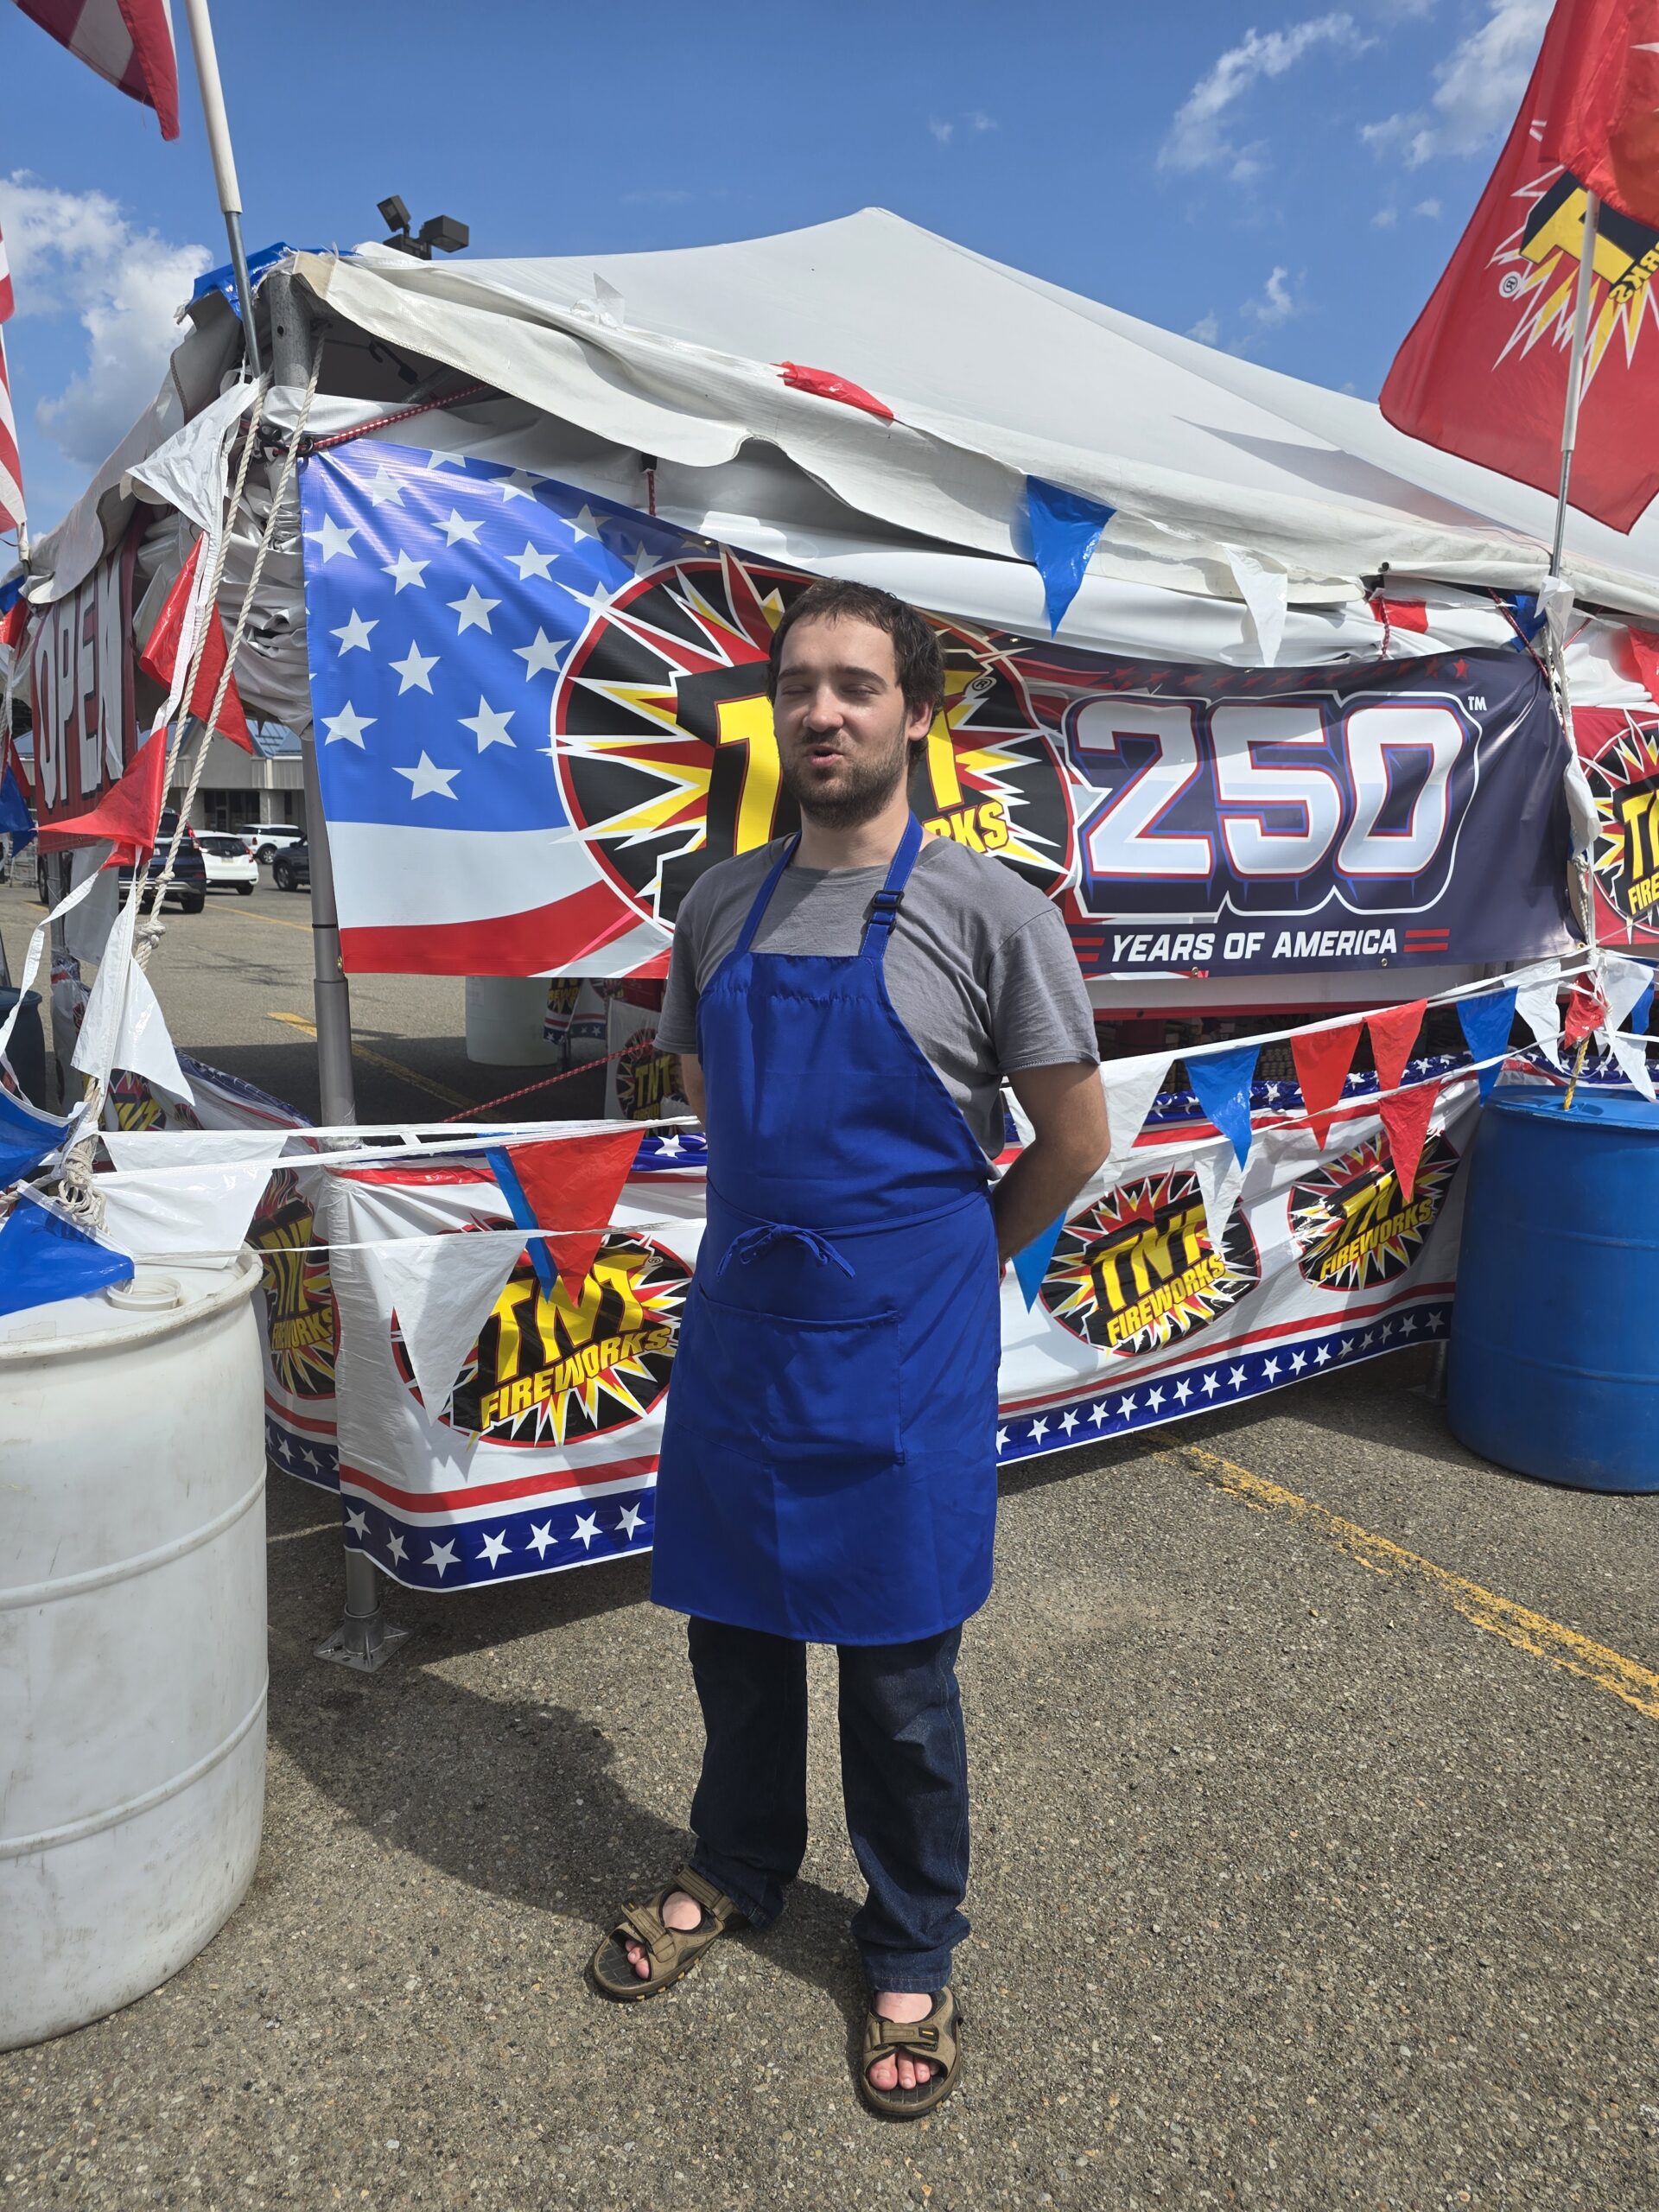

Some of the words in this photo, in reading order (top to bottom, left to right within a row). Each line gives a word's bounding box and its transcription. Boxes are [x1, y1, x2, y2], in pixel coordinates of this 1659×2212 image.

[35, 549, 123, 808] OPEN
[1076, 696, 1466, 879] 250
[1468, 696, 1487, 712] TM
[1111, 933, 1216, 963] YEARS
[1223, 931, 1266, 960] OF
[1271, 928, 1397, 958] AMERICA
[1092, 1203, 1207, 1313] TNT
[1319, 1198, 1433, 1281] FIREWORKS
[488, 1252, 650, 1384] TNT
[1106, 1252, 1226, 1346] FIREWORKS
[480, 1327, 671, 1431] FIREWORKS
